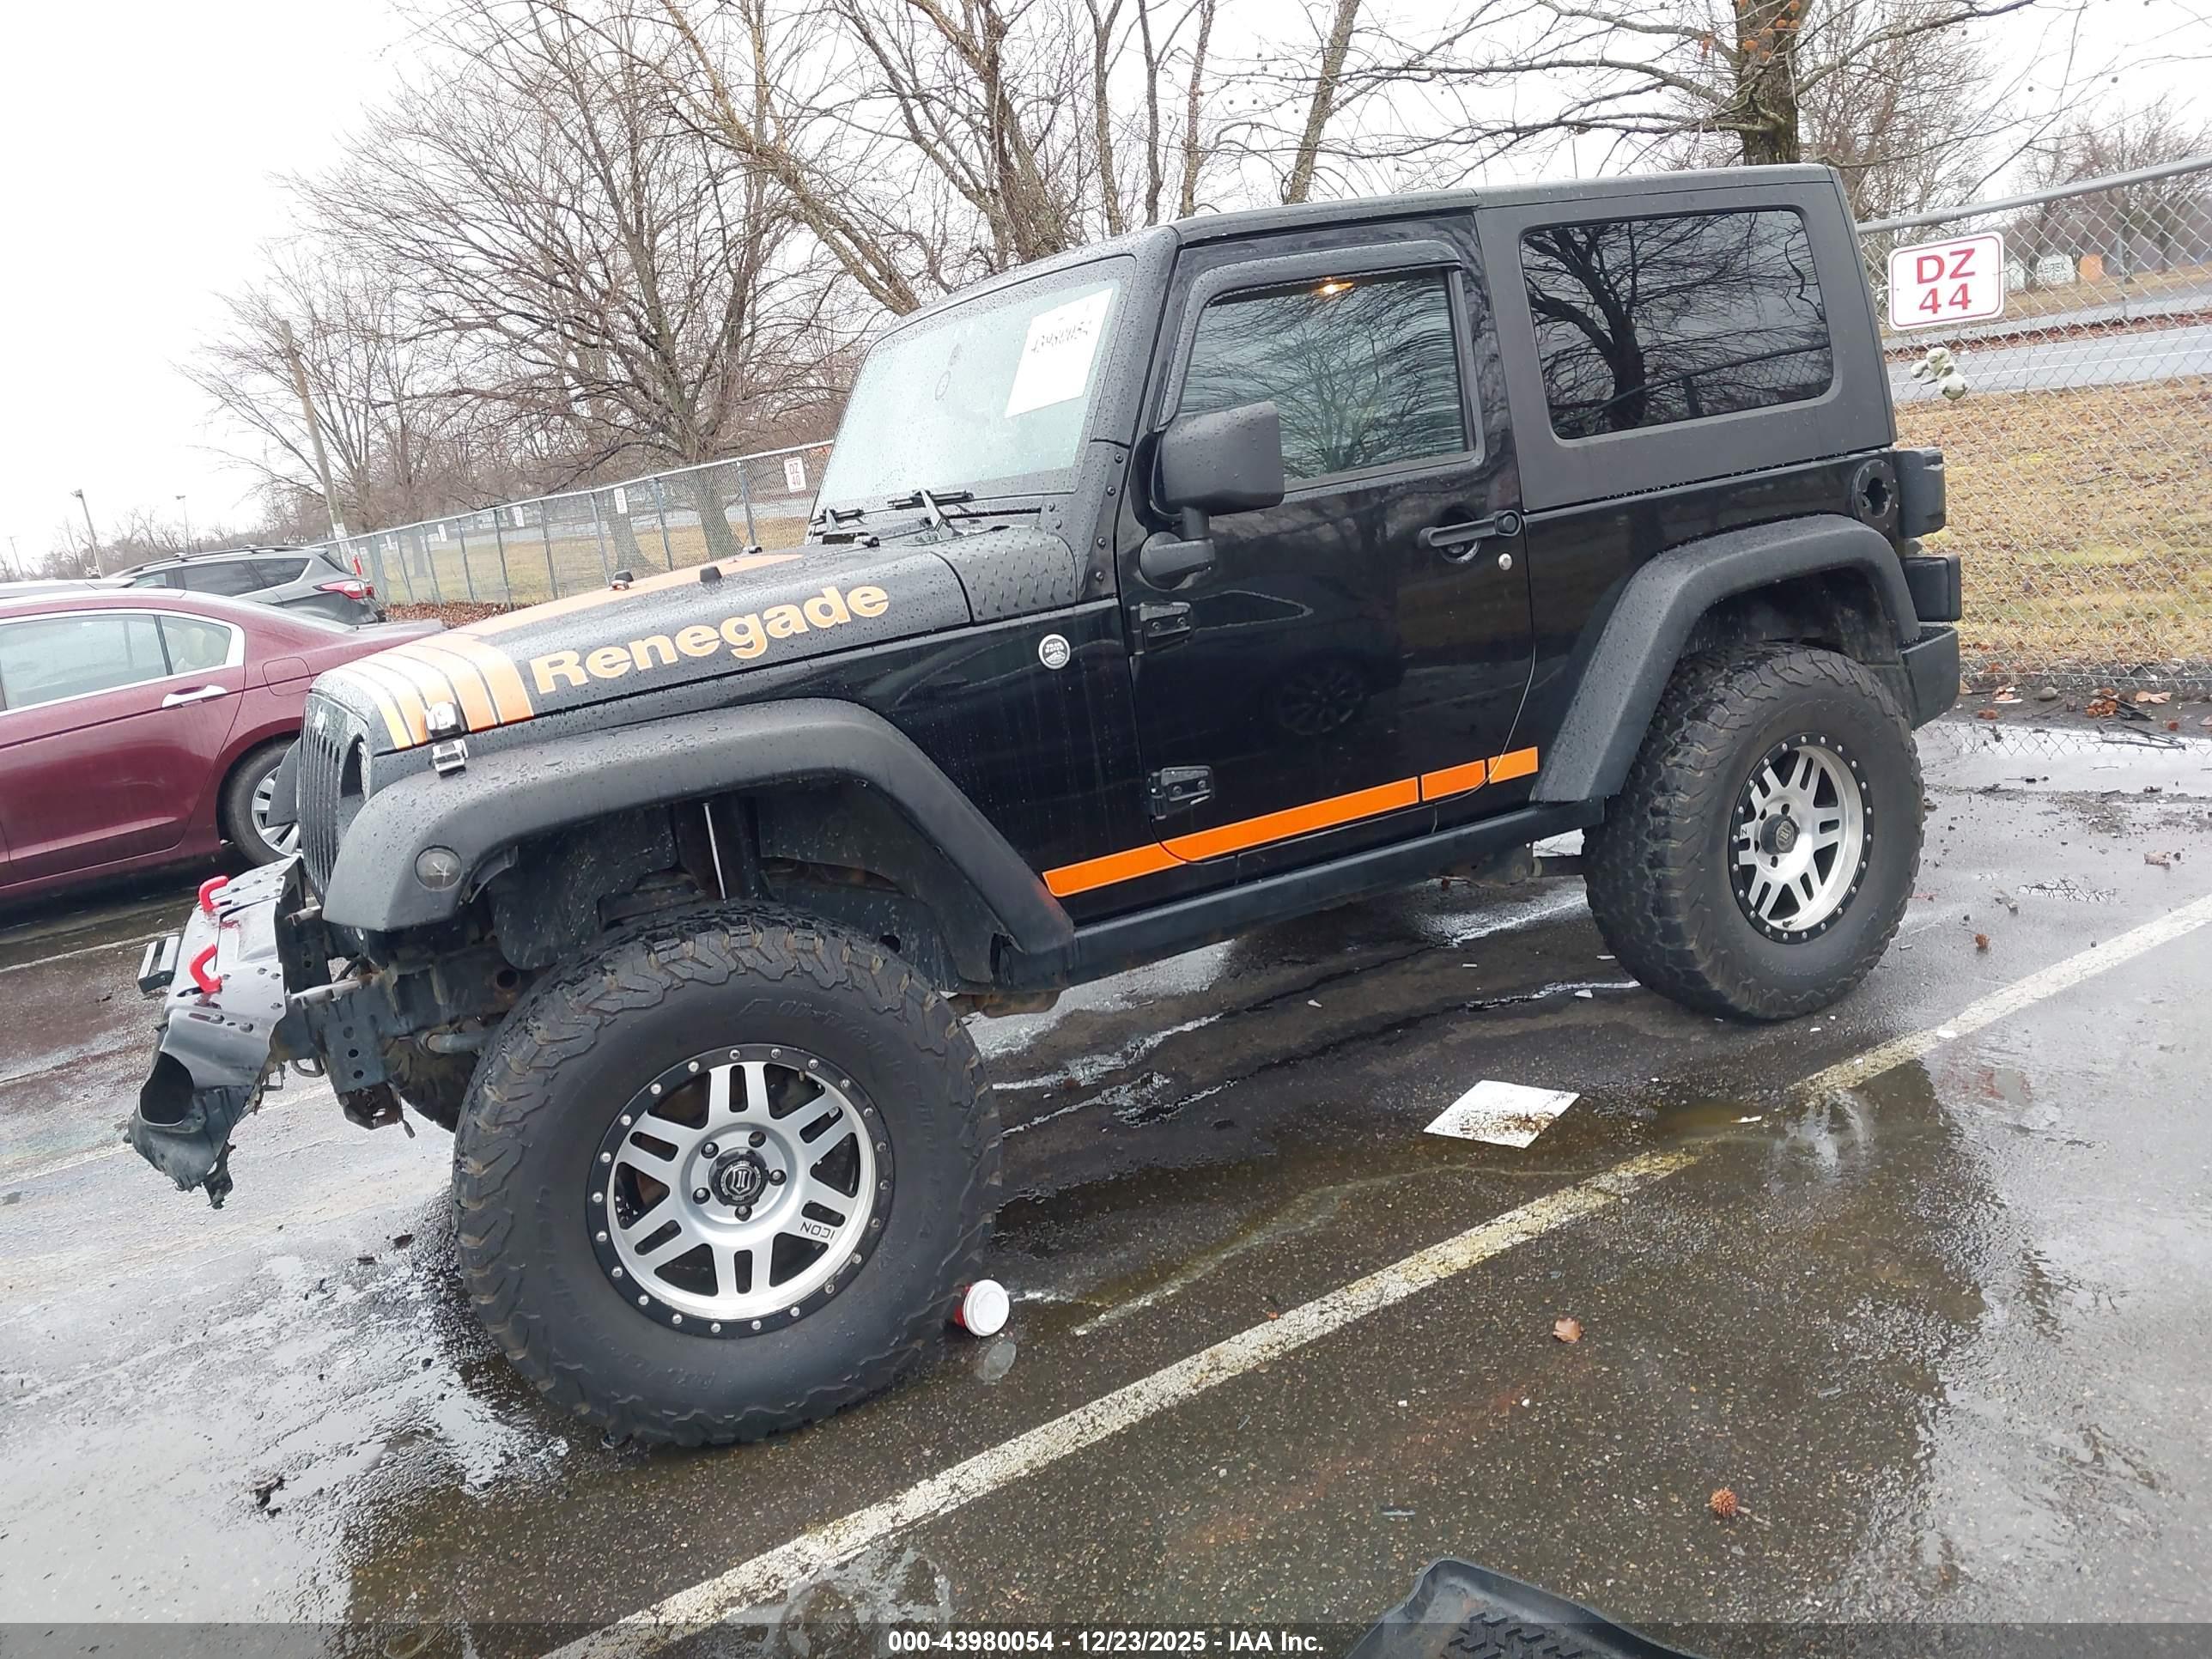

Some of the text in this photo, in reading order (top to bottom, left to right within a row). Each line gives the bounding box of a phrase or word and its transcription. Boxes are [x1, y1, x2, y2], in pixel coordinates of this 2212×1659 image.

[1916, 247, 1976, 284] DZ
[1918, 283, 1972, 315] 44
[788, 462, 800, 475] DZ
[529, 585, 890, 695] Renegade
[799, 1221, 836, 1240] ICON
